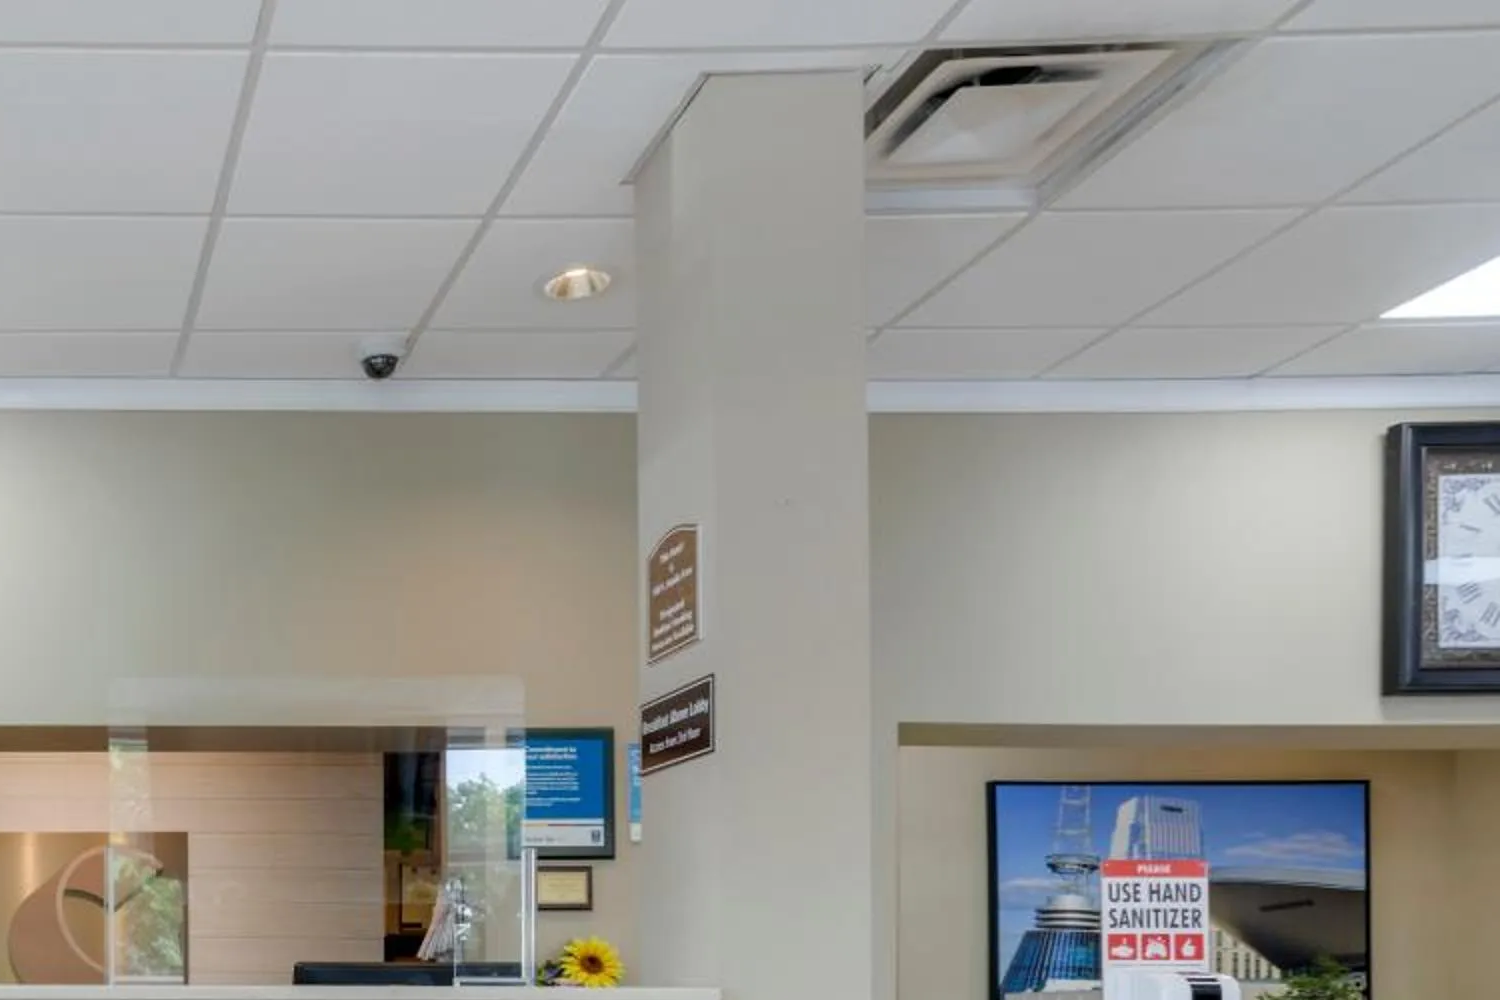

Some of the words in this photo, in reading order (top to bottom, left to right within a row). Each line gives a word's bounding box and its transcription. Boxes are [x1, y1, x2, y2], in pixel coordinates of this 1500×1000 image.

[1107, 882, 1141, 903] USE
[1148, 882, 1203, 903] HAND
[1108, 907, 1203, 929] SANITIZER
